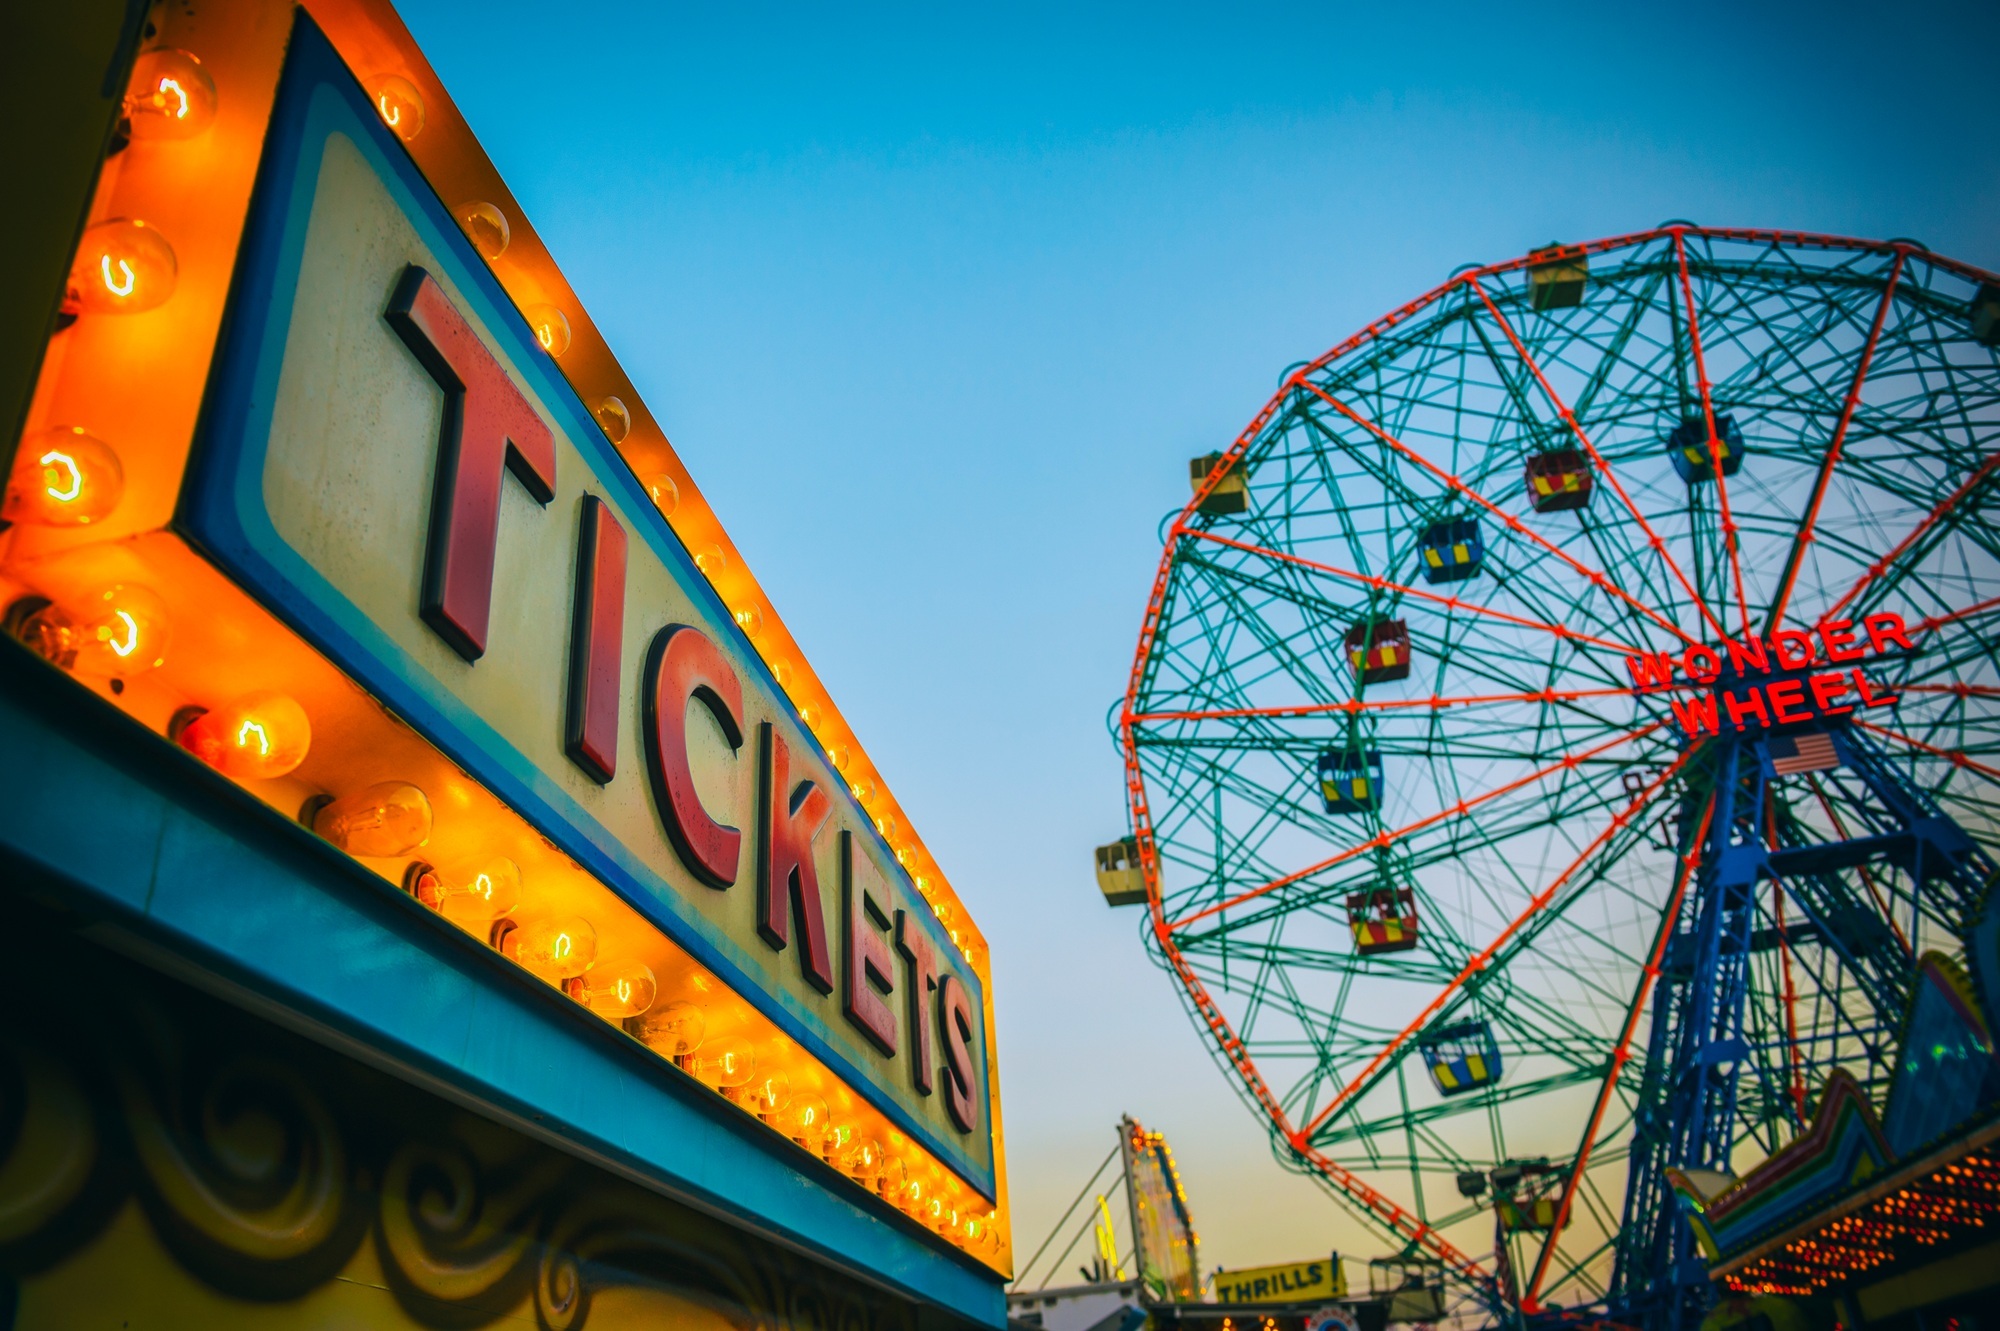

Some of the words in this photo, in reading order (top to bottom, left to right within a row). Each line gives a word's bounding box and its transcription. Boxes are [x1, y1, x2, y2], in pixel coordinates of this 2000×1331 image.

[1625, 612, 1914, 690] WONDER
[385, 264, 980, 1134] TICKETS
[1671, 668, 1898, 739] WHEEL
